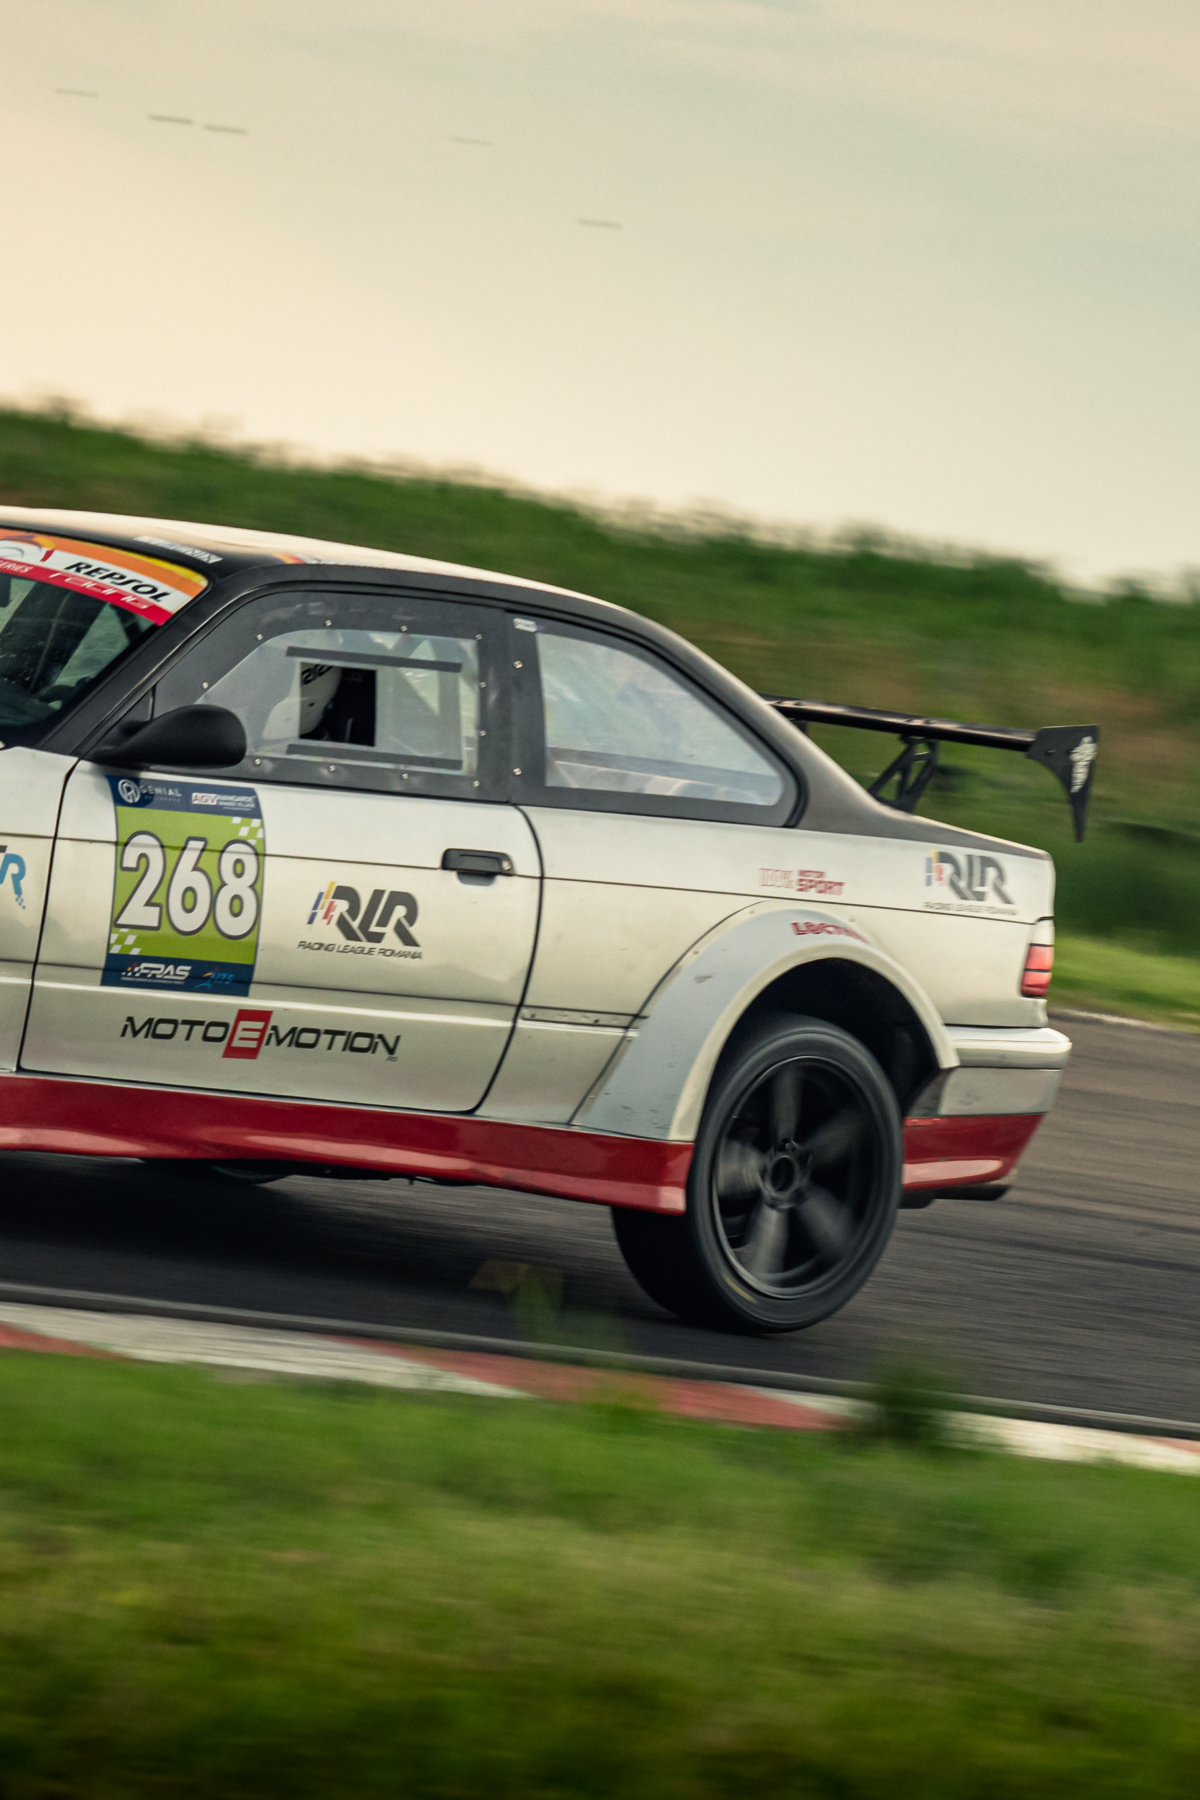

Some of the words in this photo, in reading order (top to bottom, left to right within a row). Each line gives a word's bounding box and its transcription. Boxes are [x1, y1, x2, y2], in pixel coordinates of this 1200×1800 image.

[64, 561, 171, 603] REPSOL
[114, 830, 260, 940] 268
[322, 884, 421, 947] RLR
[134, 962, 192, 980] FRAS
[297, 940, 336, 952] RACING
[336, 945, 375, 956] LEAGUE
[377, 948, 423, 960] ROMANIA
